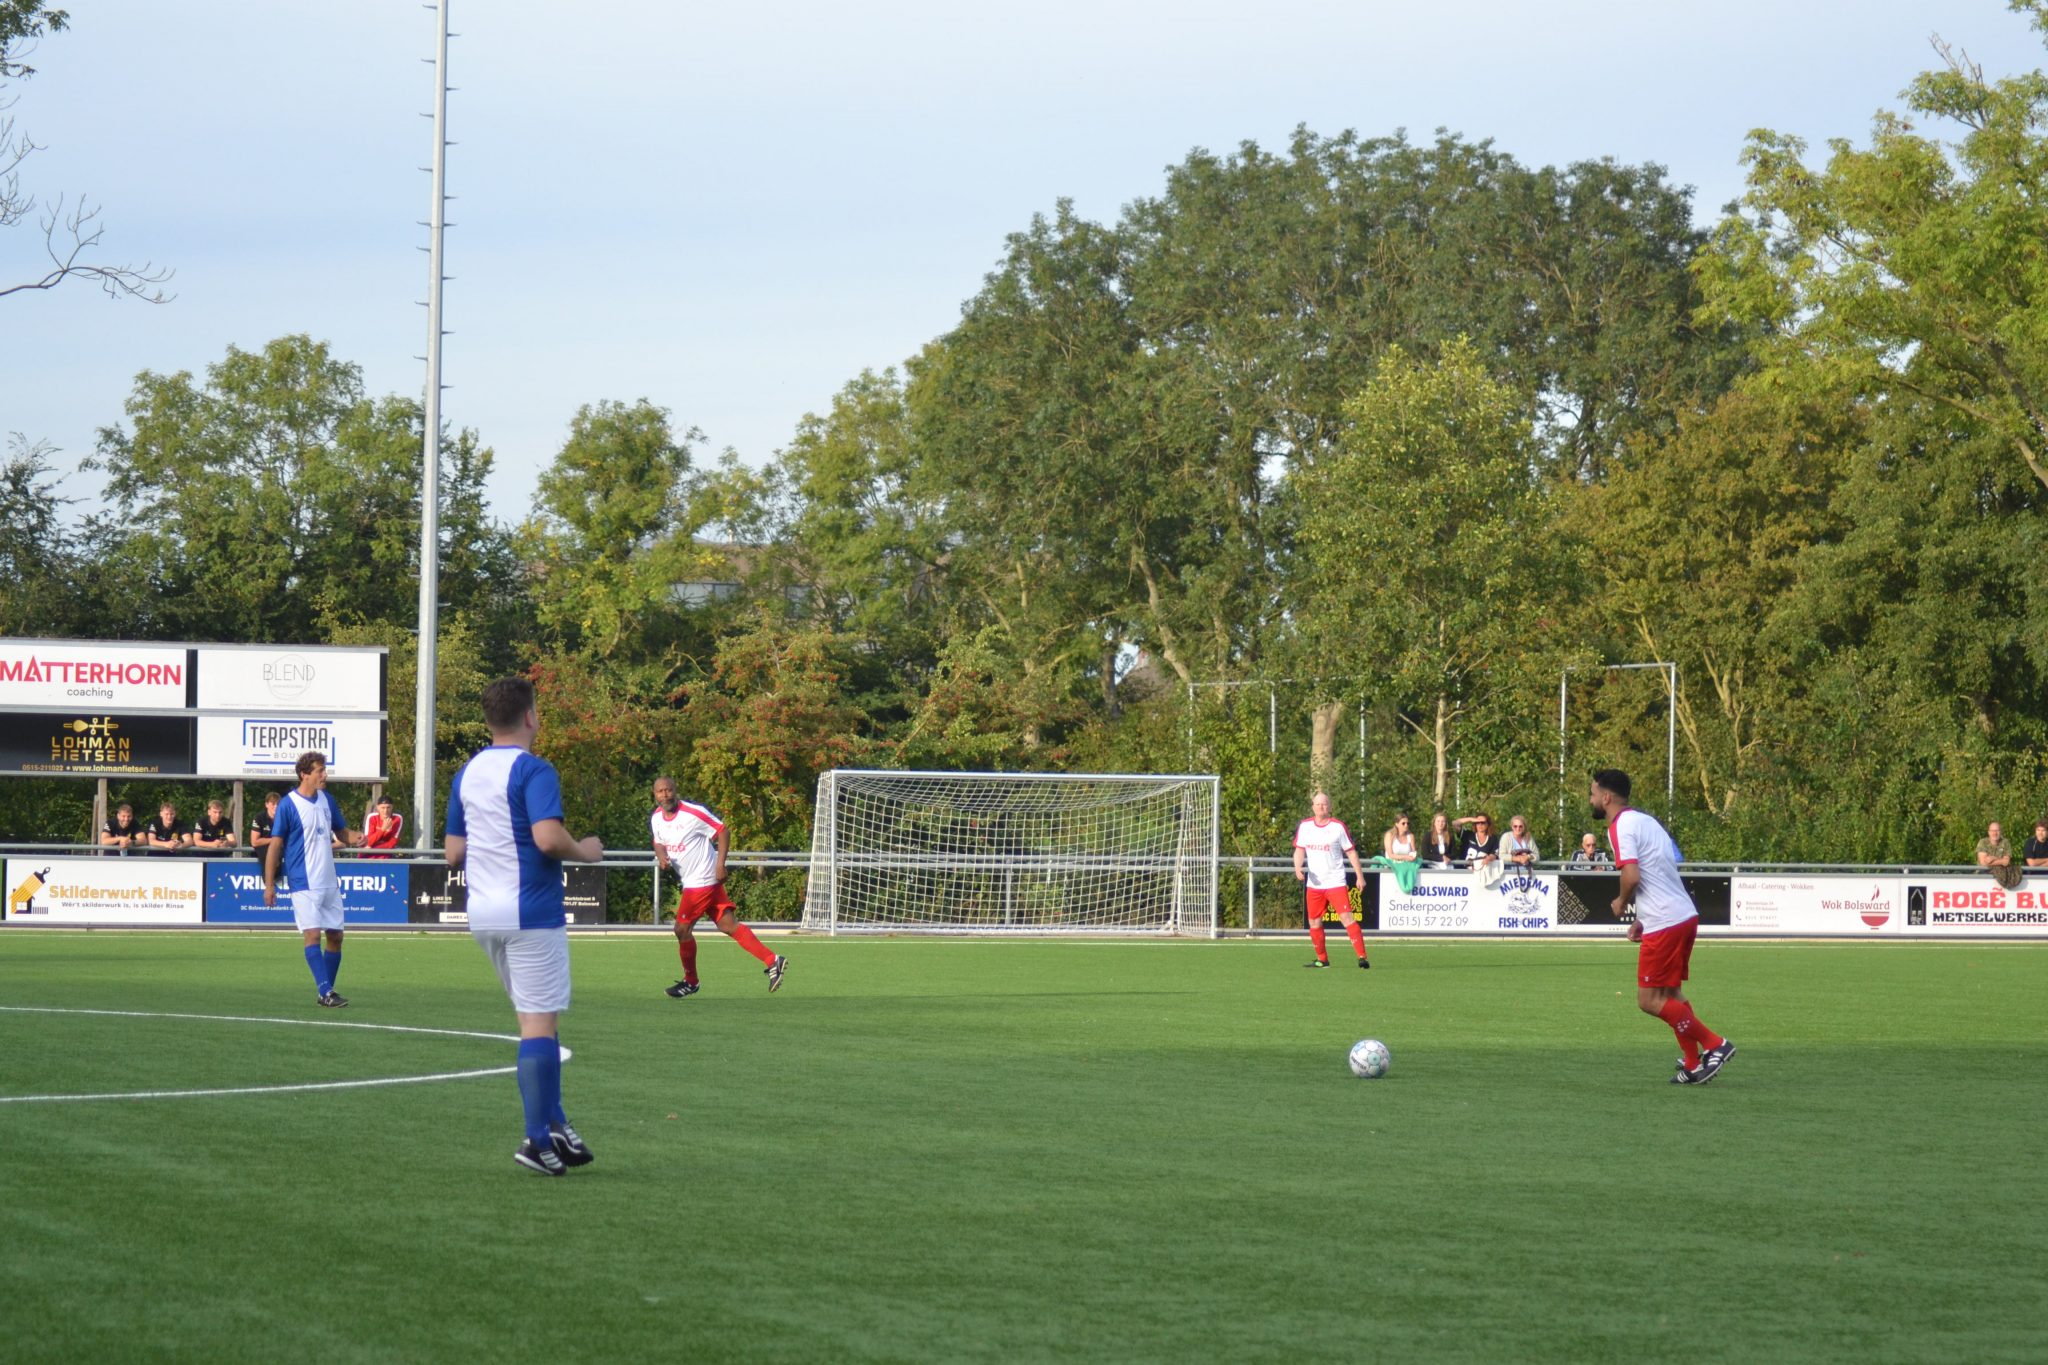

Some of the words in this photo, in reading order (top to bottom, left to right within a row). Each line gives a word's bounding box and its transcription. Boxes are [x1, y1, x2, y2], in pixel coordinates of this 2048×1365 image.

[0, 655, 181, 685] MATTERHORN
[263, 663, 315, 681] BLEND
[67, 687, 114, 699] coaching
[52, 736, 130, 749] LOHMAN
[251, 726, 328, 749] TERPSTRA
[52, 750, 130, 762] FIETSEN
[72, 765, 158, 773] www.lohmanfietsen.nl
[49, 886, 148, 899] Skilderwurk
[152, 887, 198, 899] Rinse
[1411, 886, 1469, 896] BOLSWARD
[1389, 900, 1457, 914] Snekerpoort
[1461, 901, 1468, 911] 7
[1821, 900, 1842, 910] Wok
[1844, 900, 1890, 910] Bolsward
[1388, 916, 1421, 928] (0515)
[1425, 917, 1437, 927] 57
[1440, 917, 1453, 927] 22
[1455, 917, 1469, 927] 09
[1498, 917, 1519, 928] FISH
[1522, 917, 1549, 928] CHIPS
[1932, 912, 2047, 923] METSELWERKE
